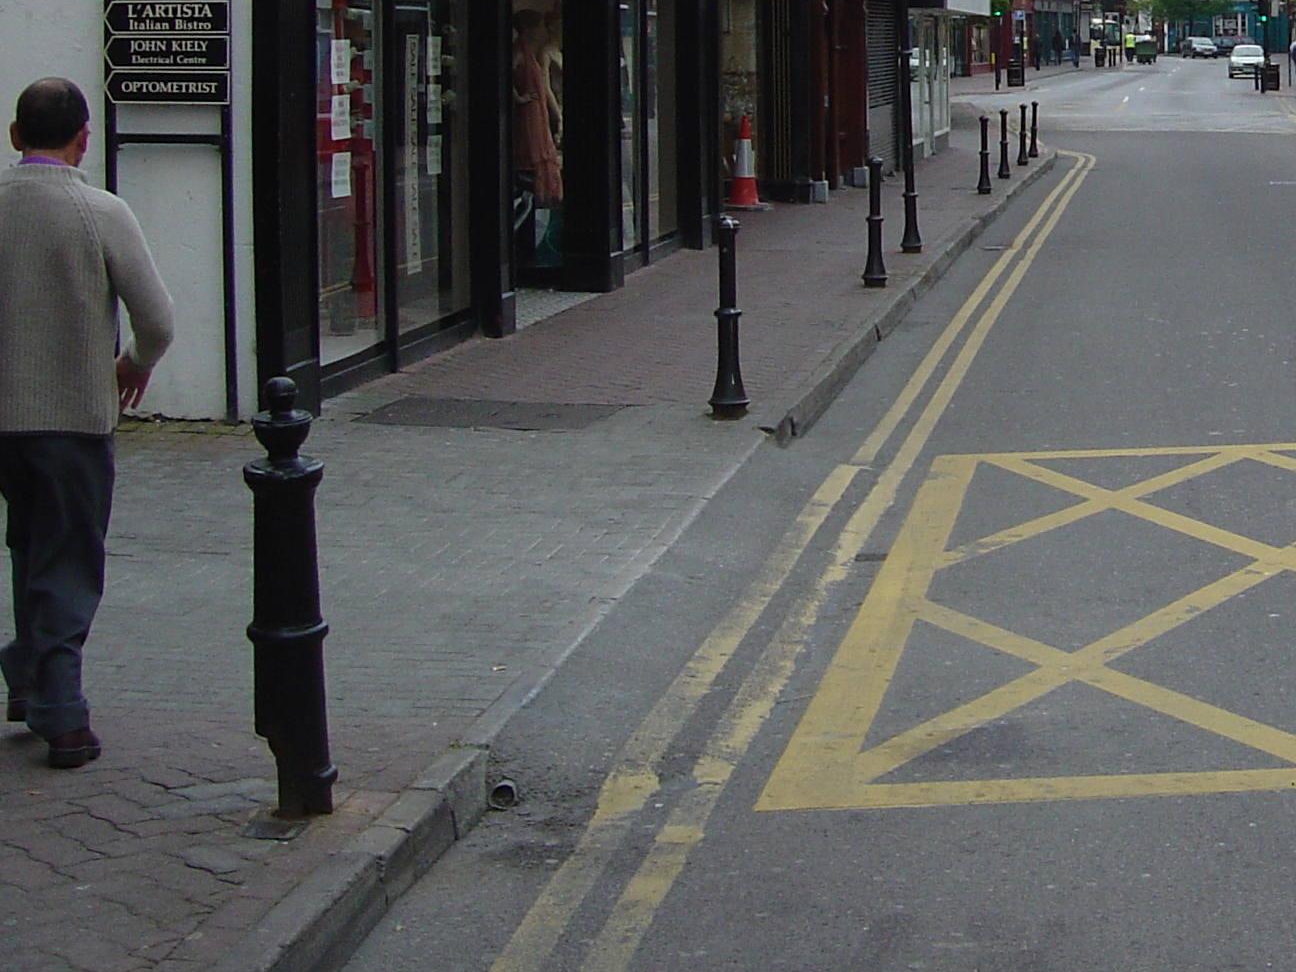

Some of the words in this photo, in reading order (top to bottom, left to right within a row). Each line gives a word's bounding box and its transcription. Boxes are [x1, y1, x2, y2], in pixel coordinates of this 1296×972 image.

[127, 3, 213, 18] L'ARTISTA
[129, 19, 170, 30] Italian
[175, 19, 212, 30] Bistro
[130, 40, 167, 53] JOHN
[171, 40, 209, 52] KIELY
[131, 54, 174, 64] Electrical
[176, 55, 207, 64] Centre
[121, 80, 218, 94] OPTOMETRIST
